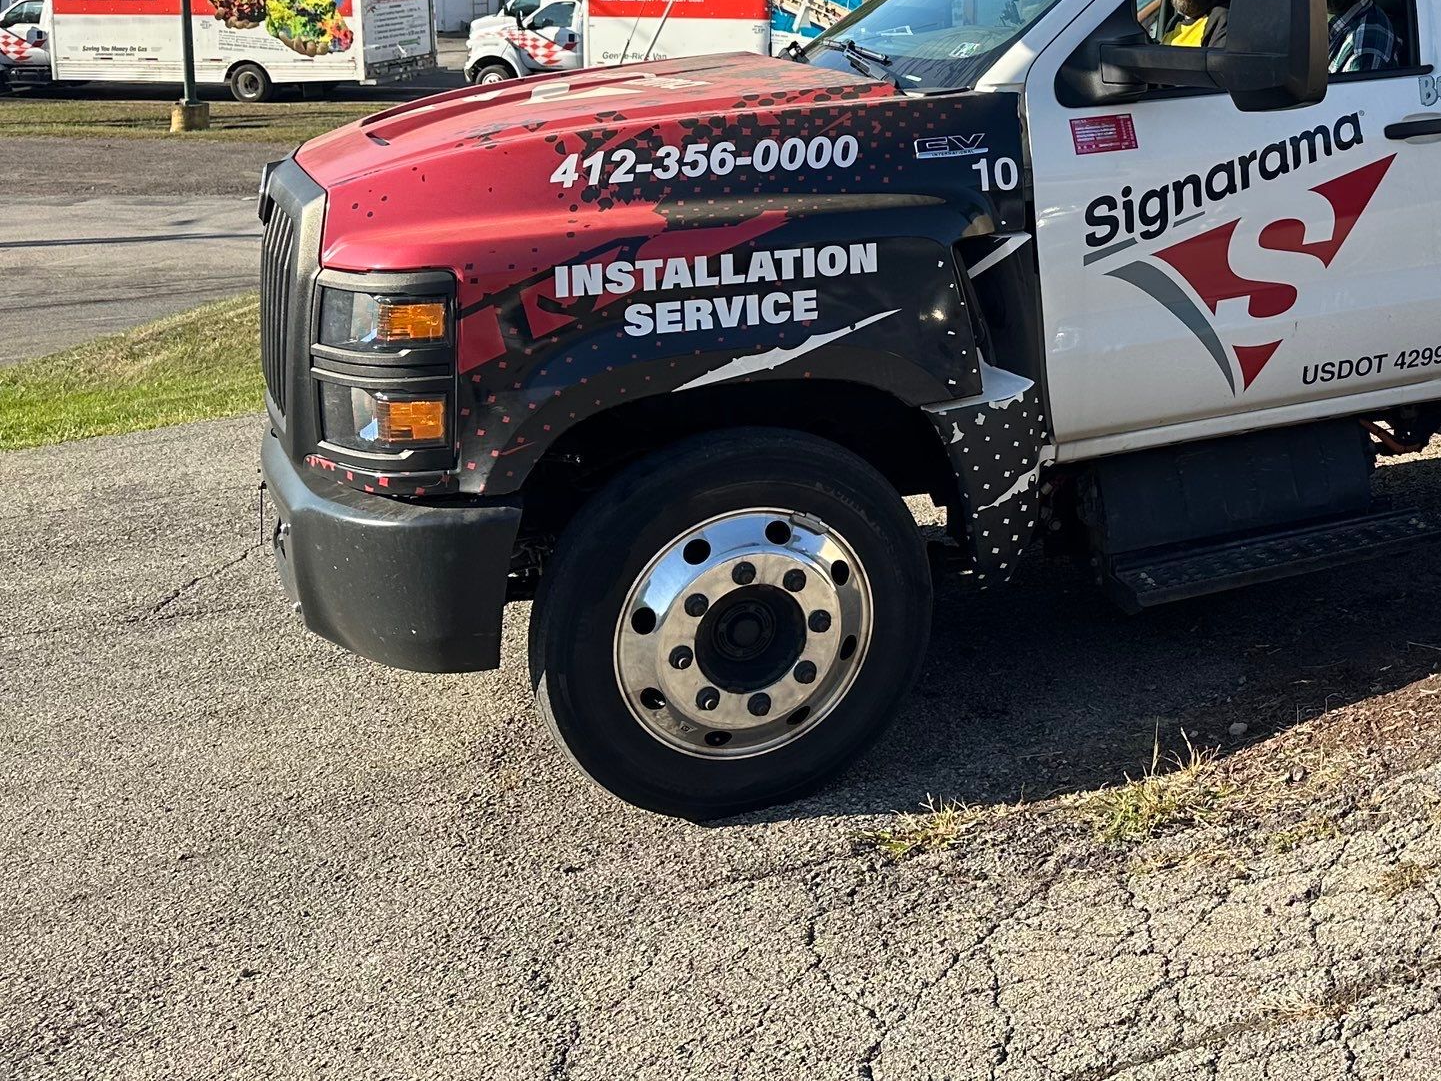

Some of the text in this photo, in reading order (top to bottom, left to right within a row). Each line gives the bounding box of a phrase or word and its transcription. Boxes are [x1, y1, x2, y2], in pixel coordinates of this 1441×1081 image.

[549, 133, 860, 189] 412-356-0000
[931, 149, 974, 157] INTERNATIONAL
[971, 156, 1019, 192] 10
[1085, 110, 1364, 247] Signarama
[554, 242, 878, 299] INSTALLATION
[623, 289, 819, 337] SERVICE
[1301, 353, 1388, 386] USDOT
